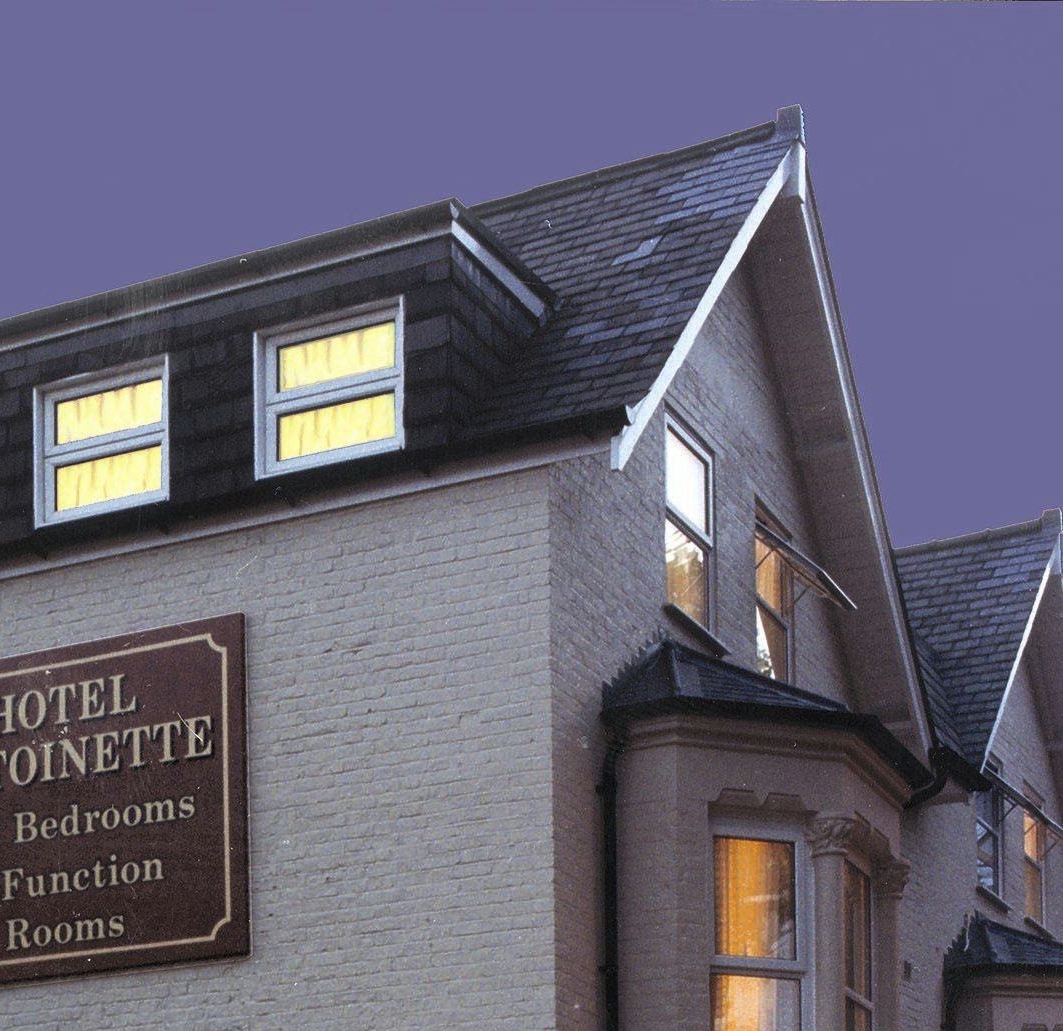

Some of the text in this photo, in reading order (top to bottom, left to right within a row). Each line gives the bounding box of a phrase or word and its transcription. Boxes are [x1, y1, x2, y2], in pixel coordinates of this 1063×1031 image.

[14, 795, 196, 843] Bedrooms
[1, 855, 165, 901] Function
[5, 915, 125, 951] Rooms
